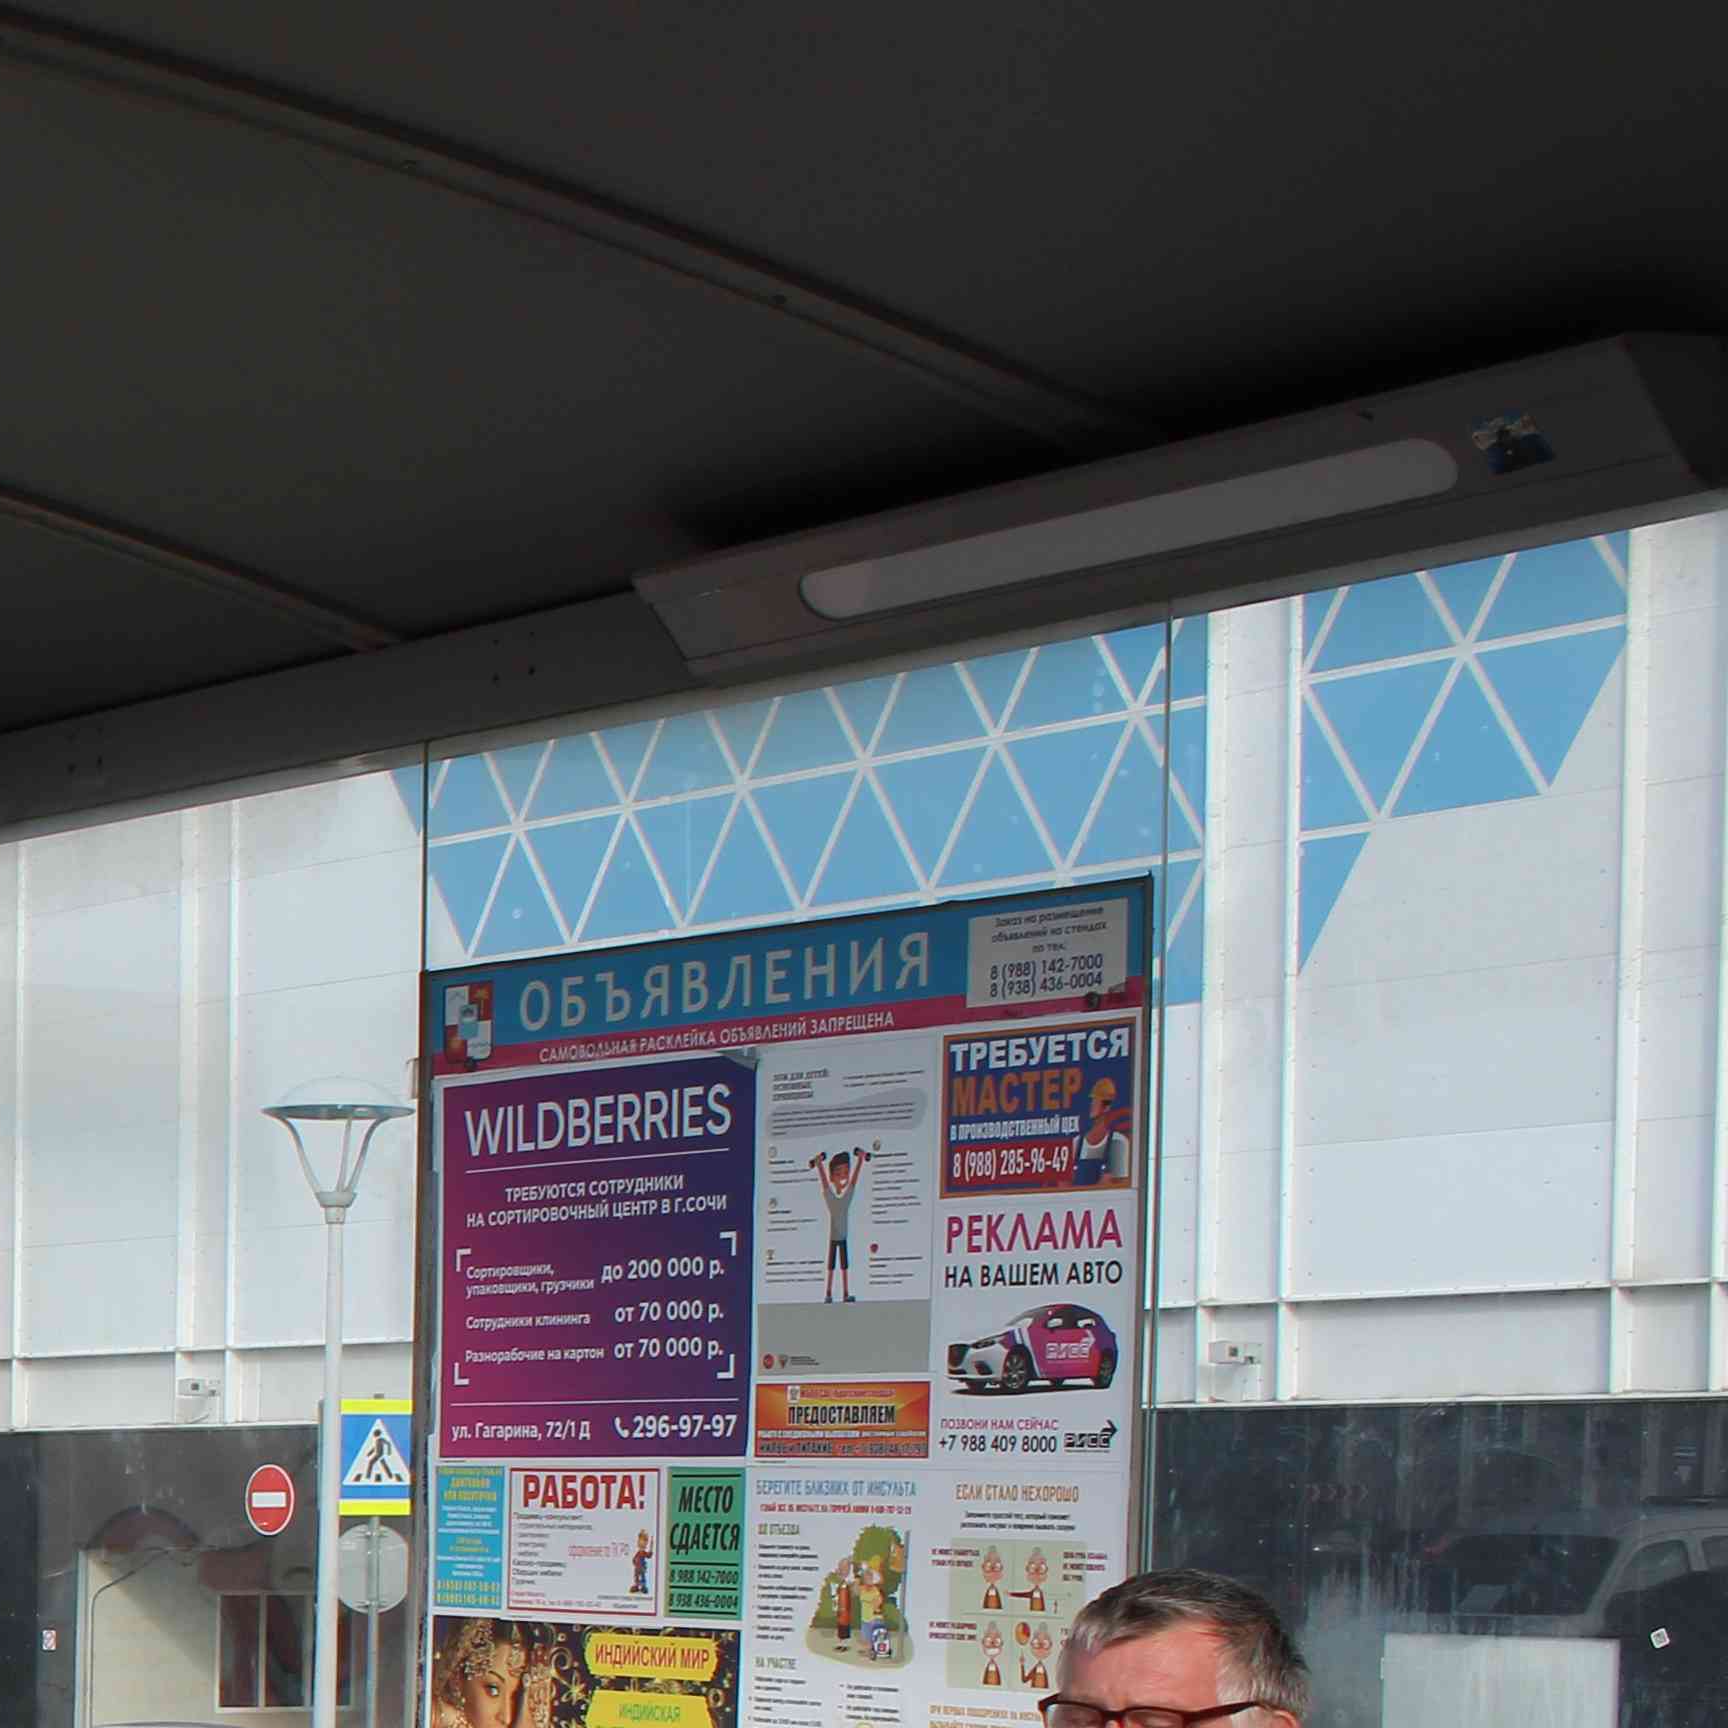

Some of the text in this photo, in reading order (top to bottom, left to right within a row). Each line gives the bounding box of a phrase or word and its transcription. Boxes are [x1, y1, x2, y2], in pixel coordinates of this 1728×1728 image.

[519, 931, 930, 1032] ОБЪЯВЛЕНИЯ
[1002, 953, 1104, 983] (988) 142-7000
[1001, 972, 1103, 1000] (938) 436-0004
[539, 1011, 895, 1063] САМОВОЛЬНАЯ РАСКЛЕЙКА ОБЪЯВЛЕНИЙ ЗАПРЕЩЕНА
[950, 1027, 1130, 1072] ТРЕБУЕТСЯ
[952, 1067, 1084, 1117] МАСТЕР
[464, 1083, 732, 1158] WILDBERRIES
[958, 1115, 1080, 1141] ПРОИЗВОДСТВЕННЫЙ ЦЕХ
[953, 1146, 1070, 1183] 8 (988) 285-96-49
[505, 1174, 685, 1203] ТРЕБУЮТСЯ СОТРУДНИКИ
[466, 1212, 485, 1228] НА
[488, 1200, 609, 1227] СОРТИРОВОЧНЫЙ
[612, 1200, 658, 1219] ЦЕНТР
[661, 1199, 671, 1215] В
[946, 1208, 1123, 1254] РЕКЛАМА
[466, 1256, 726, 1281] Сортировщики, 200 000 р.
[944, 1265, 973, 1288] НА
[980, 1262, 1060, 1287] ВАШЕМ
[1066, 1260, 1123, 1286] АВТО
[465, 1278, 595, 1300] упаковщики, грузчики
[465, 1300, 725, 1333] Сотрудники клининга от 70 000 р.
[465, 1337, 724, 1365] Разнорабочие на картон от 70 000 р.
[451, 1414, 738, 1442] ул. Гагарина, 72/1 Д 296-97-97
[788, 1405, 897, 1426] ПРЕДОСТАВЛЯЕМ
[940, 1416, 1059, 1431] ПОЗВОНИ НАМ СЕЙЧАС
[939, 1435, 957, 1452] +7
[961, 1435, 986, 1453] 988
[990, 1434, 1017, 1453] 409
[1021, 1434, 1058, 1454] 8000
[522, 1474, 647, 1510] РАБОТА!
[678, 1485, 733, 1513] МЕСТО
[756, 1480, 918, 1498] БЕРЕГИТЕ БЛИЗКИХ ОТ ИНСУЛЬТА
[956, 1484, 1080, 1503] ЕСЛИ СТАЛО НЕХОРОШО
[670, 1522, 740, 1555] СДАЕТСЯ
[678, 1569, 739, 1585] 988 142-7000
[595, 1641, 711, 1670] ИНДИЙСКИЙ МИР
[619, 1700, 681, 1722] ИНДИЙСКАЯ
